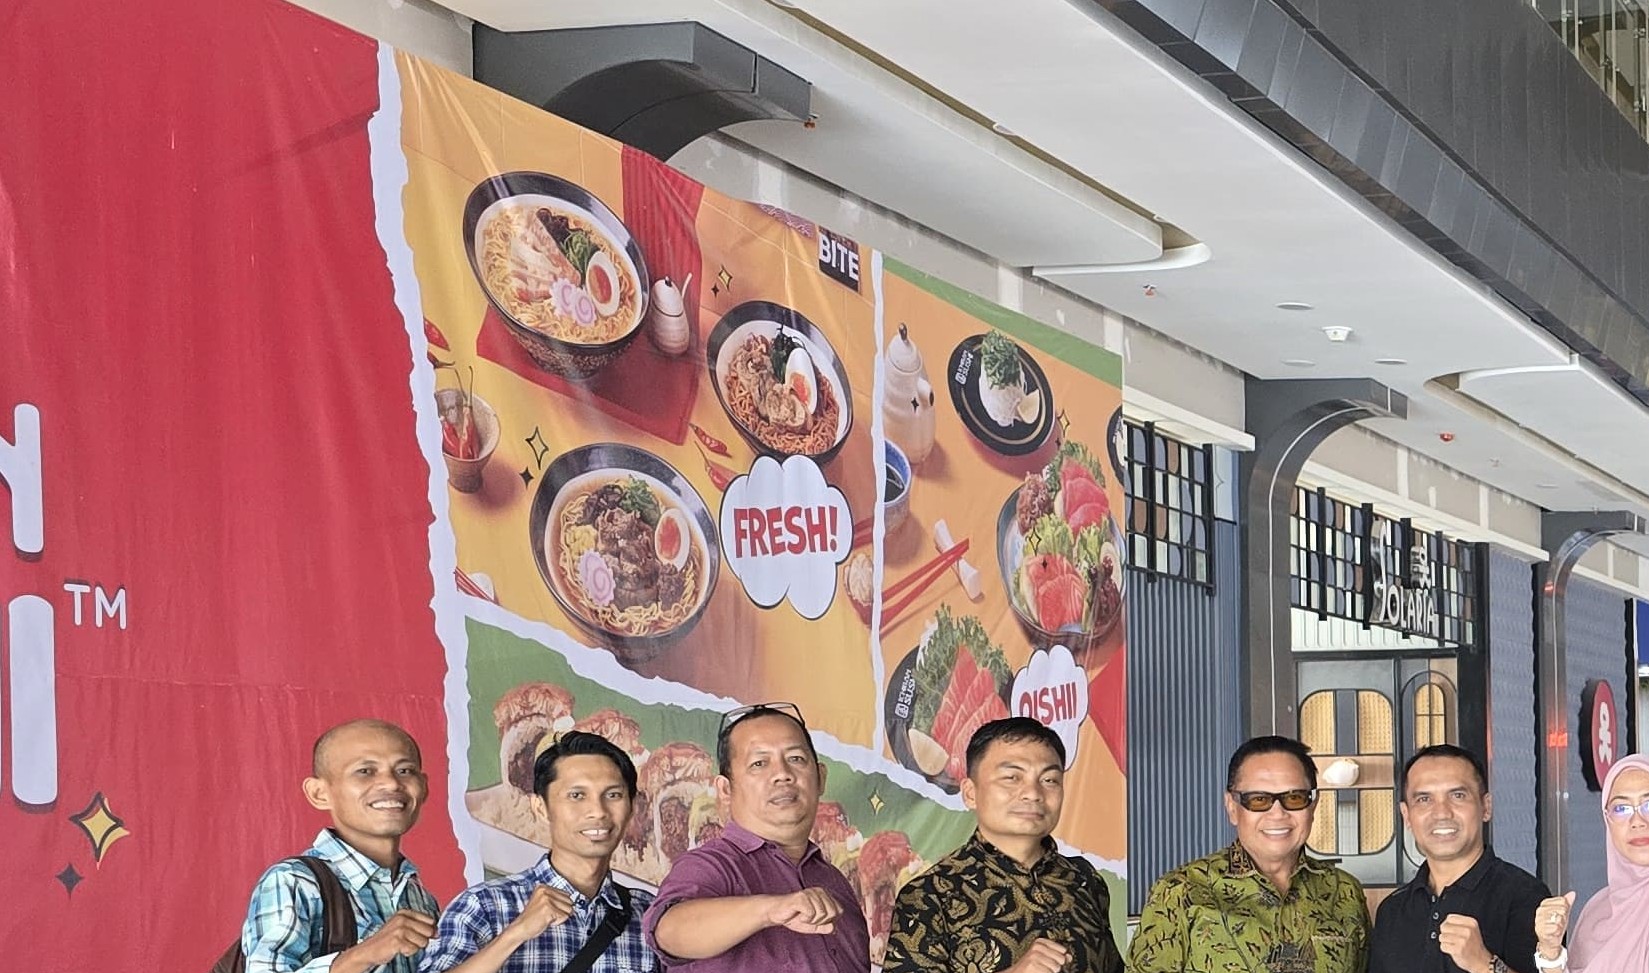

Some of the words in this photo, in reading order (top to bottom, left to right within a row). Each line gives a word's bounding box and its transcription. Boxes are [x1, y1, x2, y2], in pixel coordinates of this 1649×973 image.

[819, 234, 859, 281] BITE
[734, 505, 838, 558] FRESH!
[1019, 682, 1078, 725] OISHII
